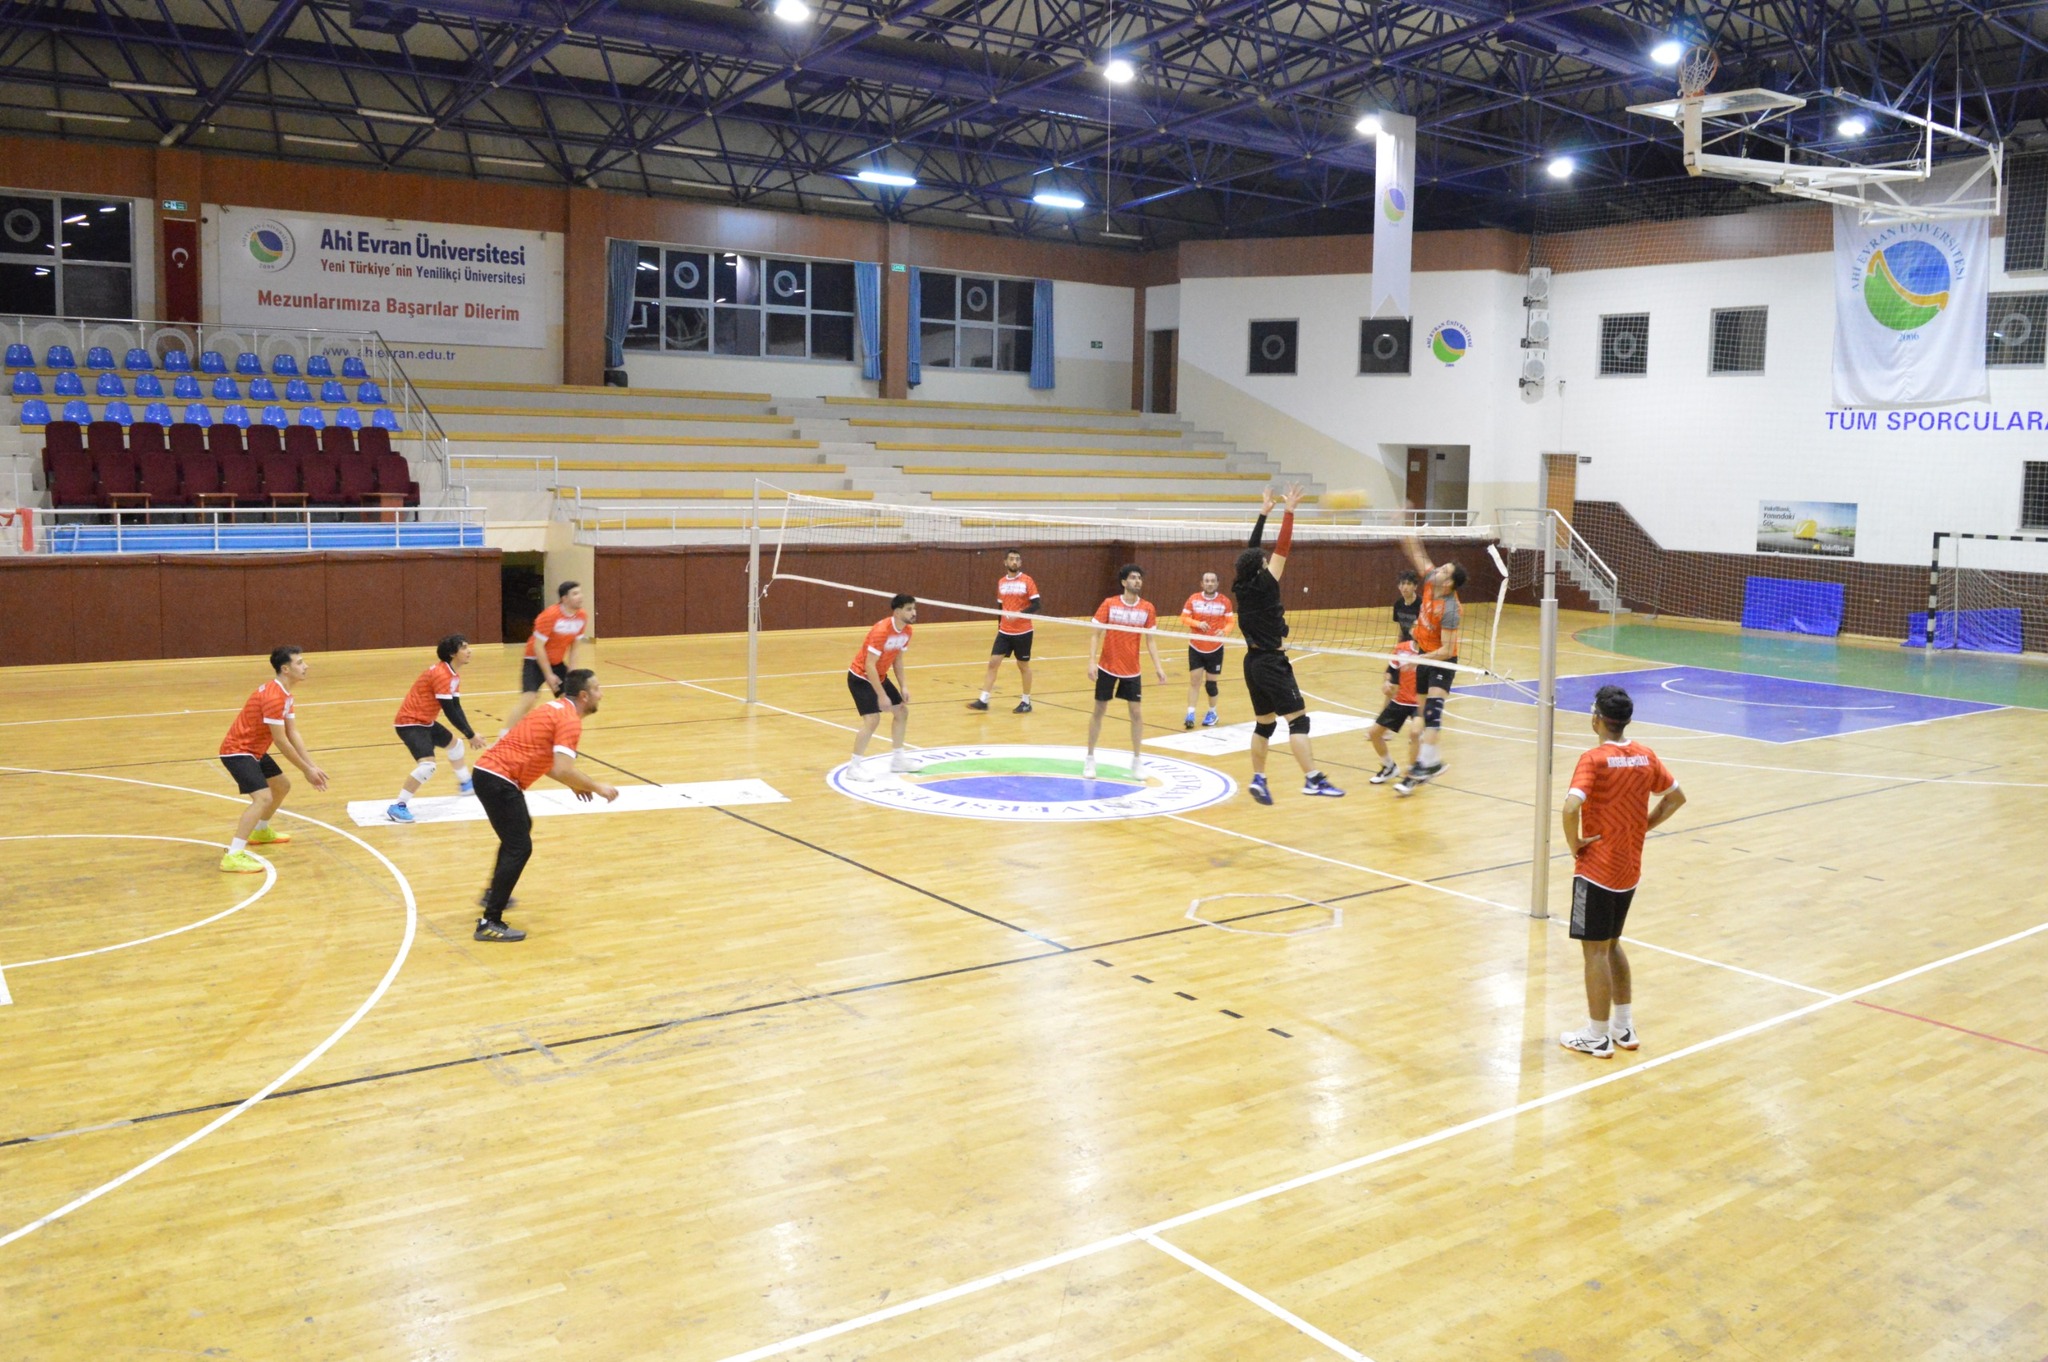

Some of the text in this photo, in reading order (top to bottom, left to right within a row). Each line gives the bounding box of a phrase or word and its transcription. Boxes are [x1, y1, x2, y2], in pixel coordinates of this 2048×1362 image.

[320, 228, 526, 266] Ahi Evran Üniversitesi
[1856, 228, 1897, 265] EVRAN
[320, 259, 346, 273] Yeni
[416, 265, 462, 283] Yenilikçi
[464, 266, 526, 285] Üniversitesi
[257, 289, 521, 322] Mezunlarımıza Başarılar Dilerim
[1825, 407, 2048, 432] TÜM SPORCULAR
